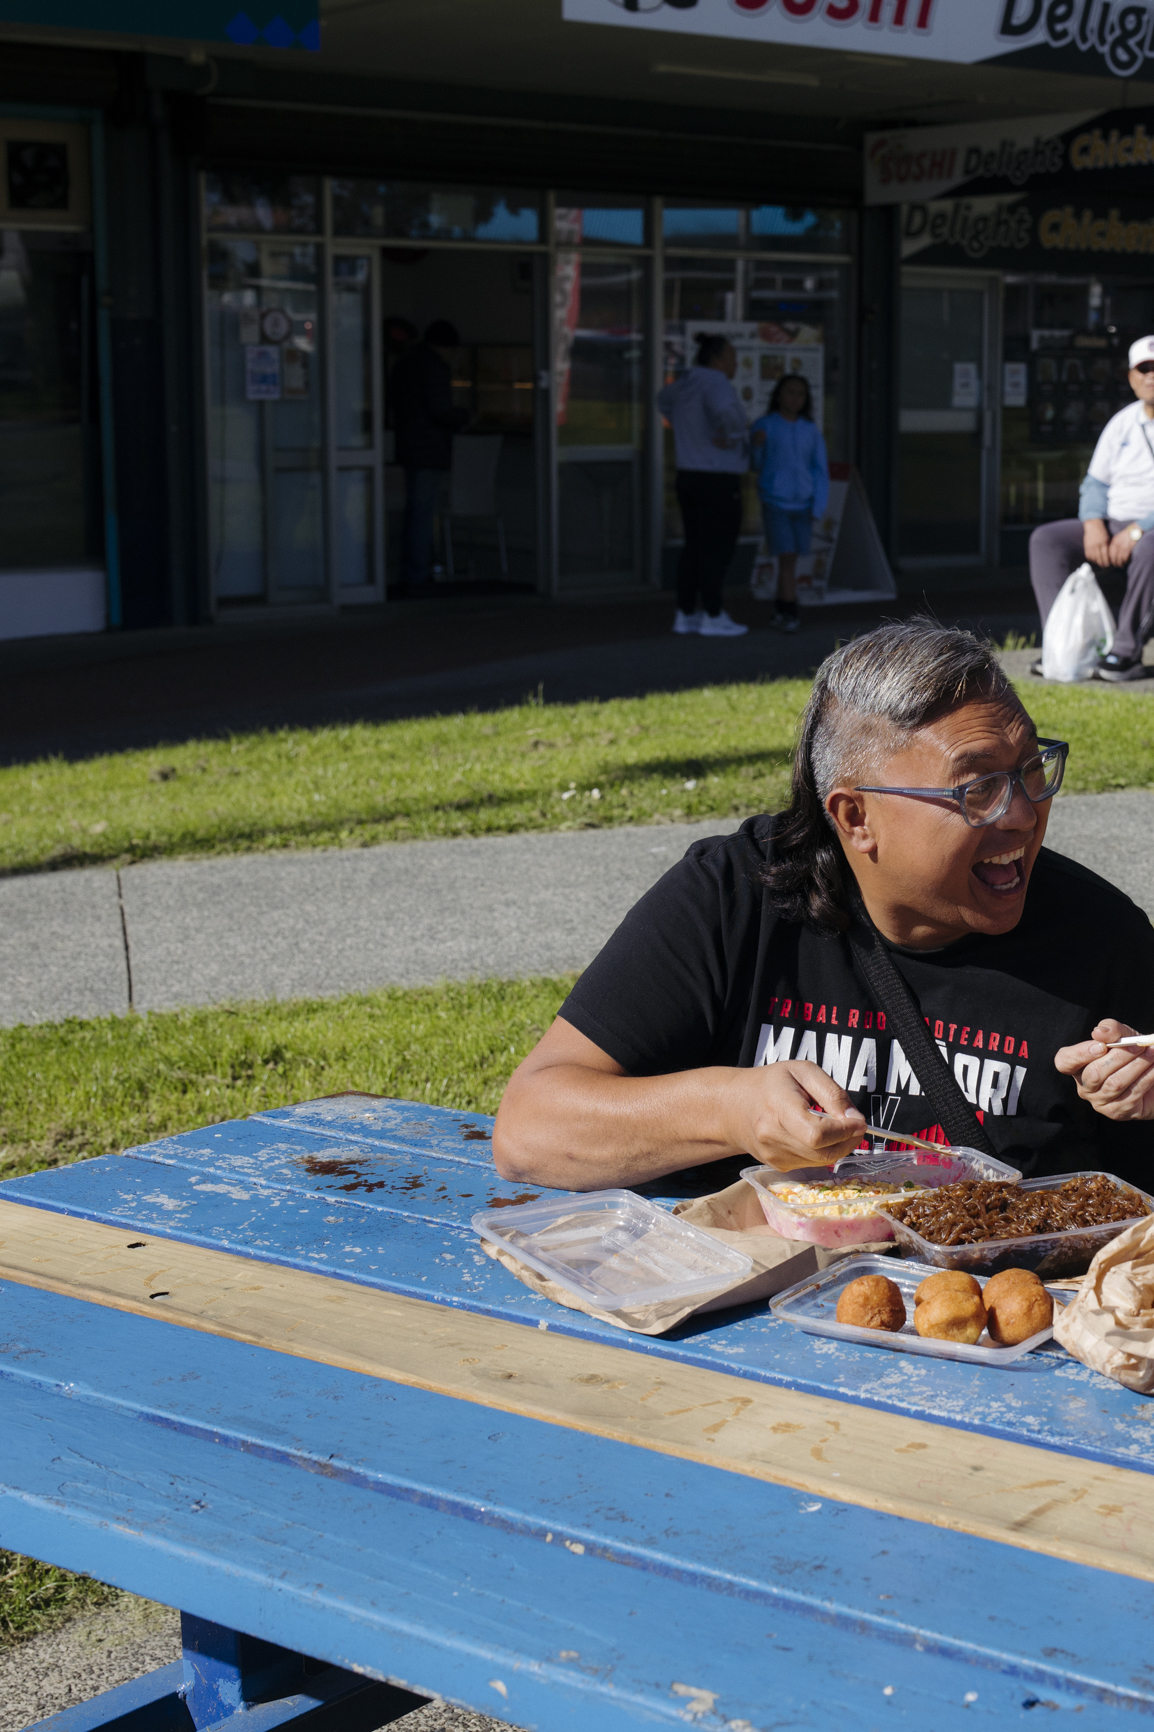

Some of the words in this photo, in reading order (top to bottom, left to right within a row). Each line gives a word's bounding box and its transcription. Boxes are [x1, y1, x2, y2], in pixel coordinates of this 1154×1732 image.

[880, 148, 957, 184] SUSHI
[963, 136, 1064, 185] Delight
[903, 202, 1033, 259] Delight
[768, 997, 838, 1025] TRIBAL
[848, 1008, 887, 1030] ROO
[753, 1023, 877, 1092] MANA
[885, 1038, 1027, 1116] MORI
